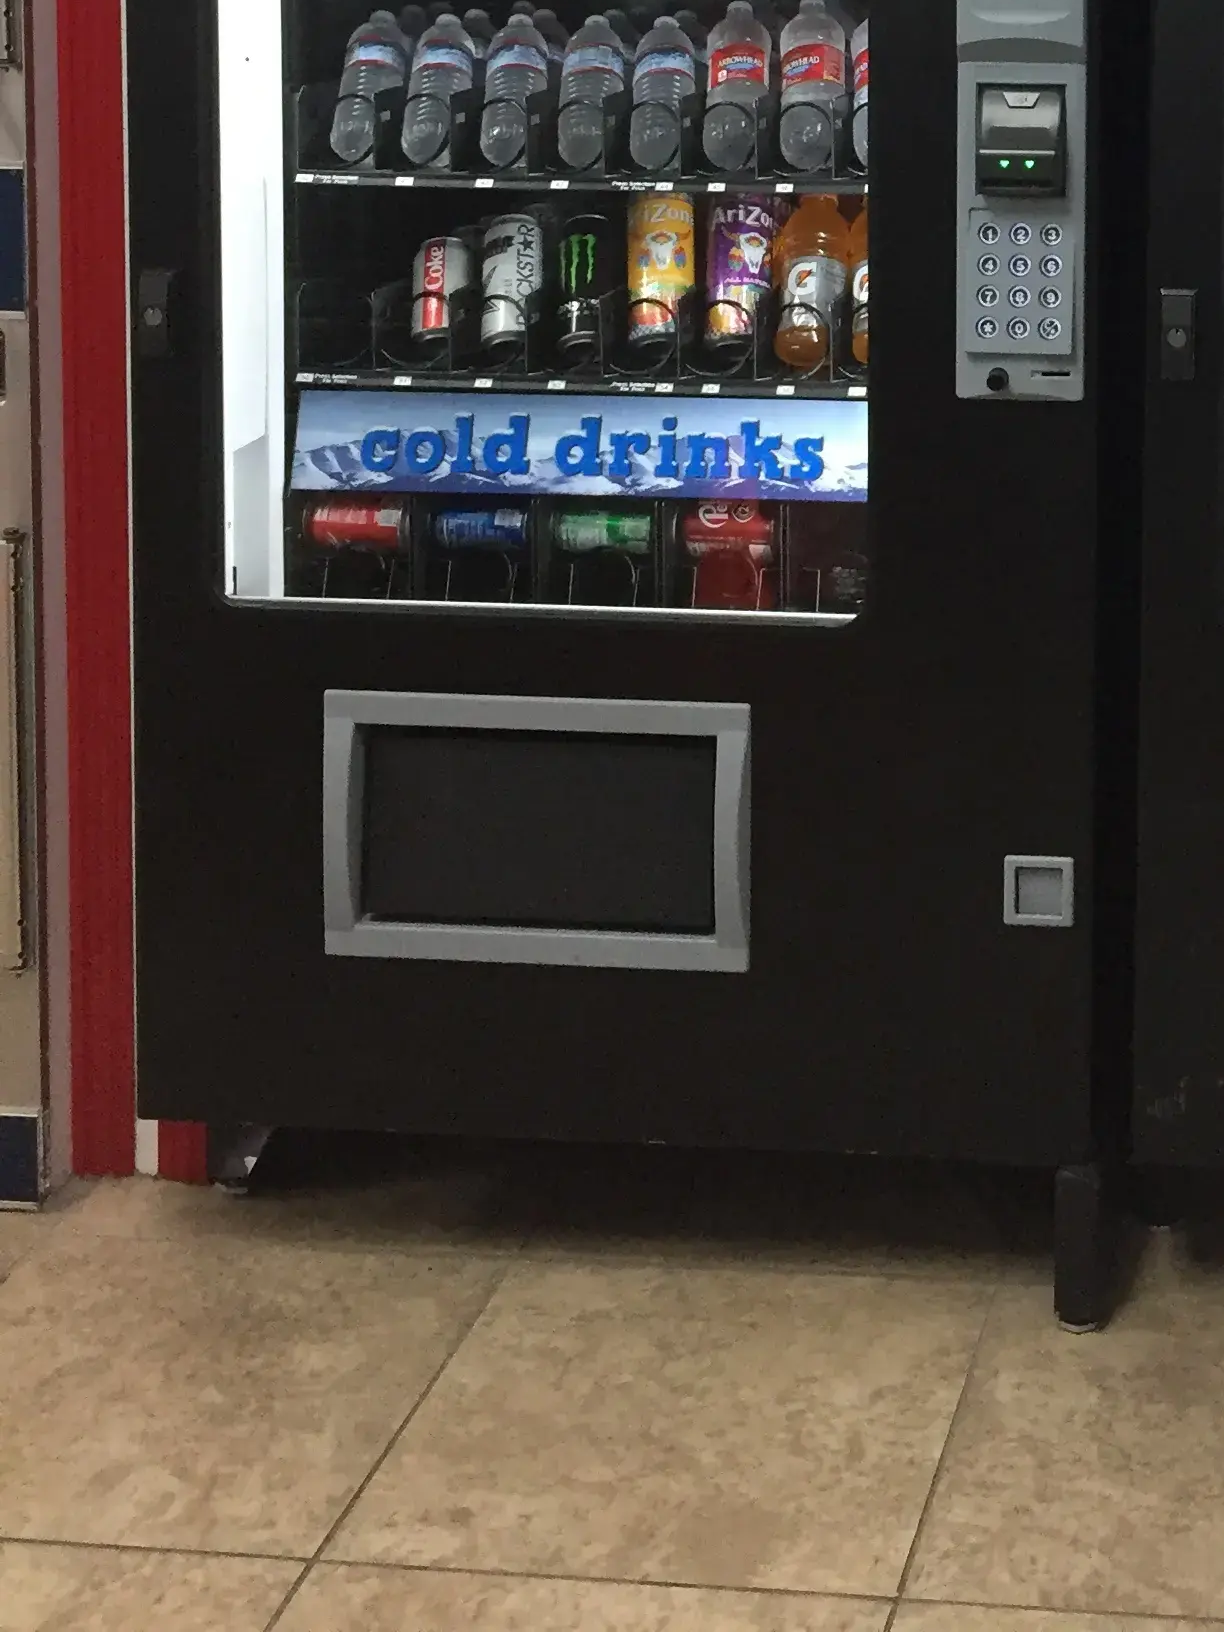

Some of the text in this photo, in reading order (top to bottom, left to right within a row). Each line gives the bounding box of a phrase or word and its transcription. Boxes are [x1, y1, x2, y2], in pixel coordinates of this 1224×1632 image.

[424, 245, 445, 292] Coke
[788, 261, 818, 297] G
[361, 412, 826, 481] cold drinks
